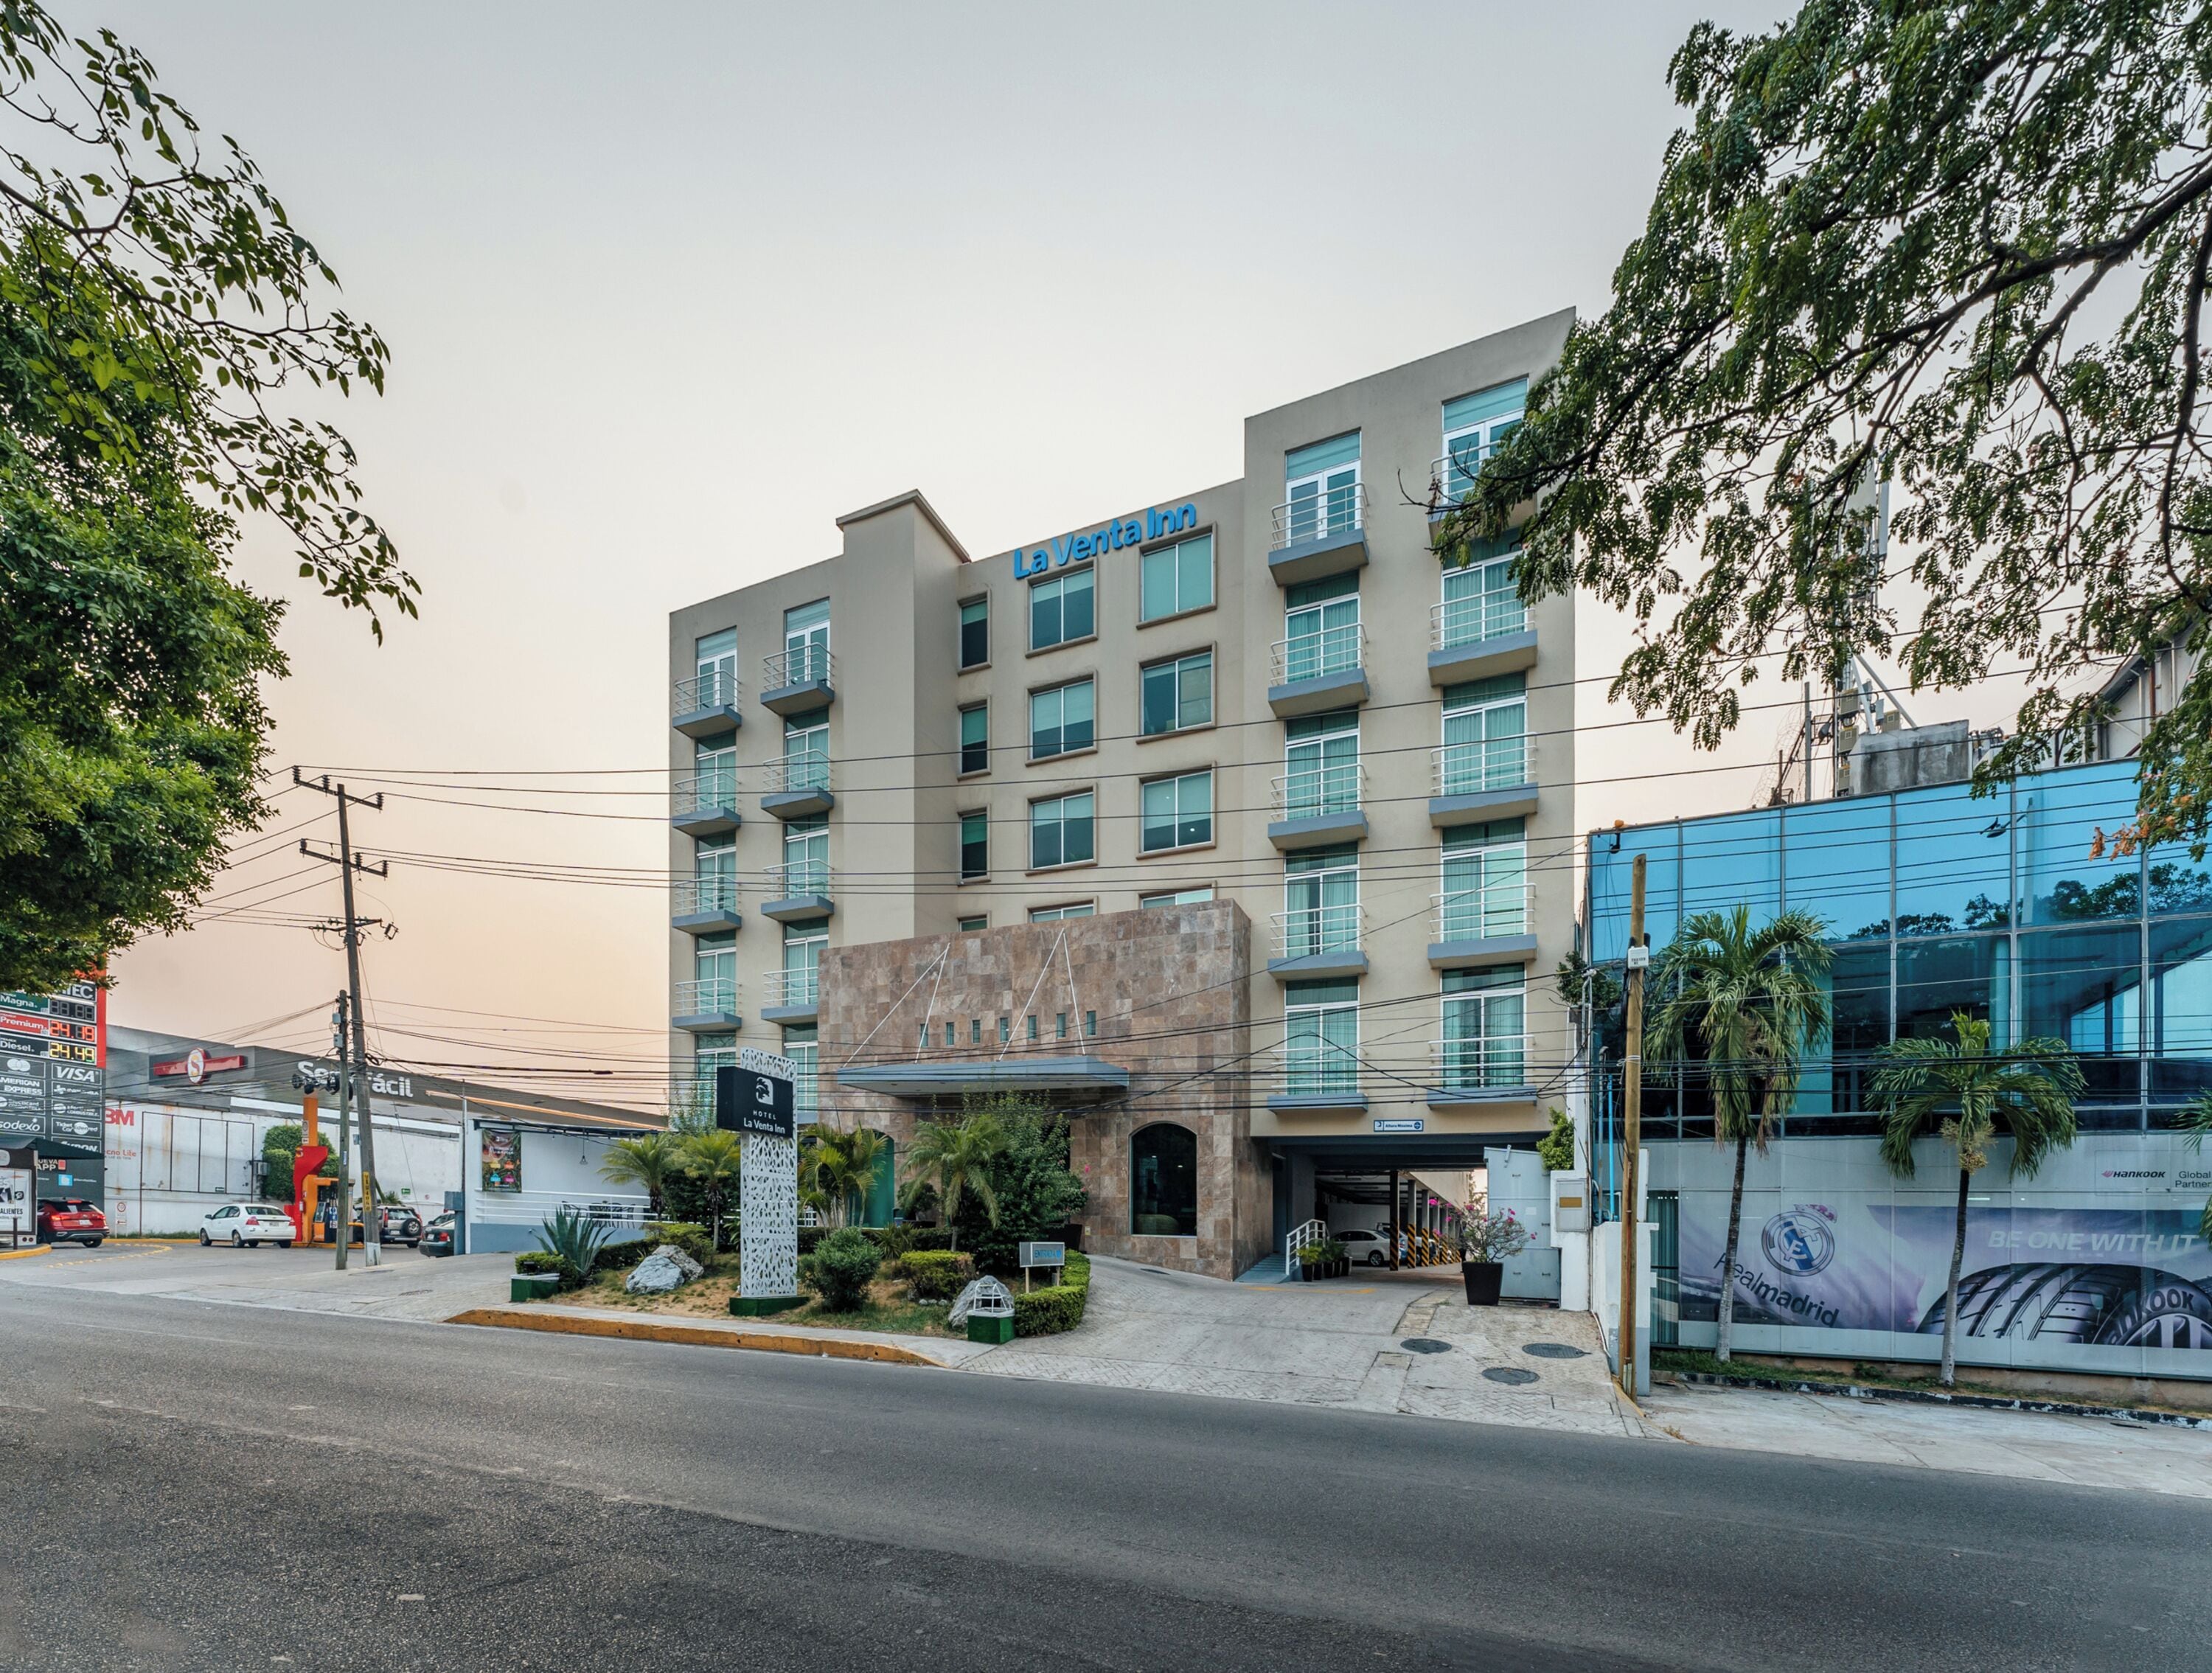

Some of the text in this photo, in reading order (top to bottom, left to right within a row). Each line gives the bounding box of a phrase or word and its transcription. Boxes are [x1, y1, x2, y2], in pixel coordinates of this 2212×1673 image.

[1014, 501, 1197, 580] La Venta Inn
[0, 995, 35, 1007] Magna
[0, 1016, 44, 1029] Premium
[50, 1020, 94, 1041] 24.19
[0, 1040, 31, 1051] Diesel
[50, 1043, 94, 1062] 24.49
[55, 1065, 95, 1082] VISA
[4, 1085, 43, 1095] EXPRESS
[753, 1110, 776, 1120] HOTEL
[743, 1117, 785, 1134] La Venta Inn
[2178, 1170, 2211, 1179] Global
[2174, 1180, 2212, 1188] Partner
[1988, 1231, 2200, 1253] BE ONE WITH IT
